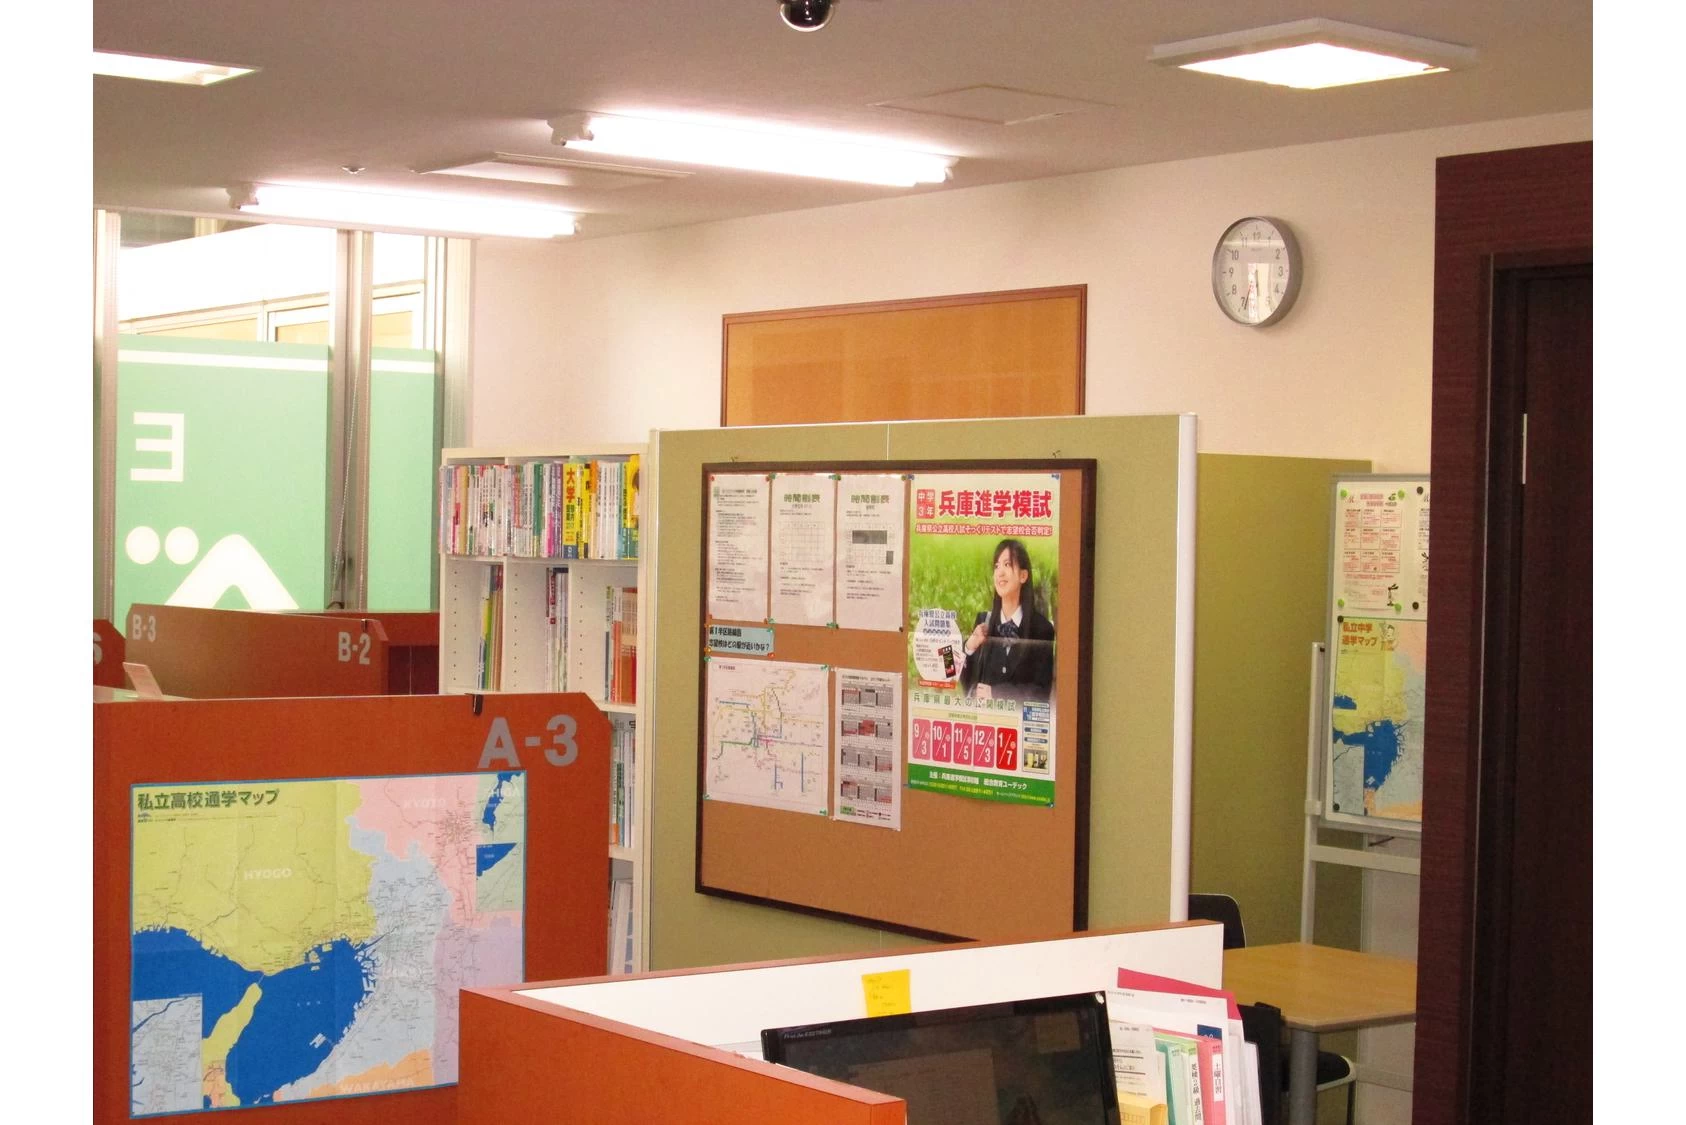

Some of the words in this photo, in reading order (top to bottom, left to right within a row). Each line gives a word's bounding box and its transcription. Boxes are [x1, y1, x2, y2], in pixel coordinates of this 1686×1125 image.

[939, 489, 1052, 518] 兵庫進学模試
[131, 614, 157, 642] B-3
[1343, 622, 1373, 633] 私立中学
[338, 631, 371, 665] B-2
[1342, 635, 1378, 646] 通学マップ
[914, 692, 1017, 712] 兵庫県最大の公開模試
[477, 714, 578, 767] A-3
[137, 788, 281, 811] 私立高校通学マップ
[243, 867, 293, 881] HYOGO
